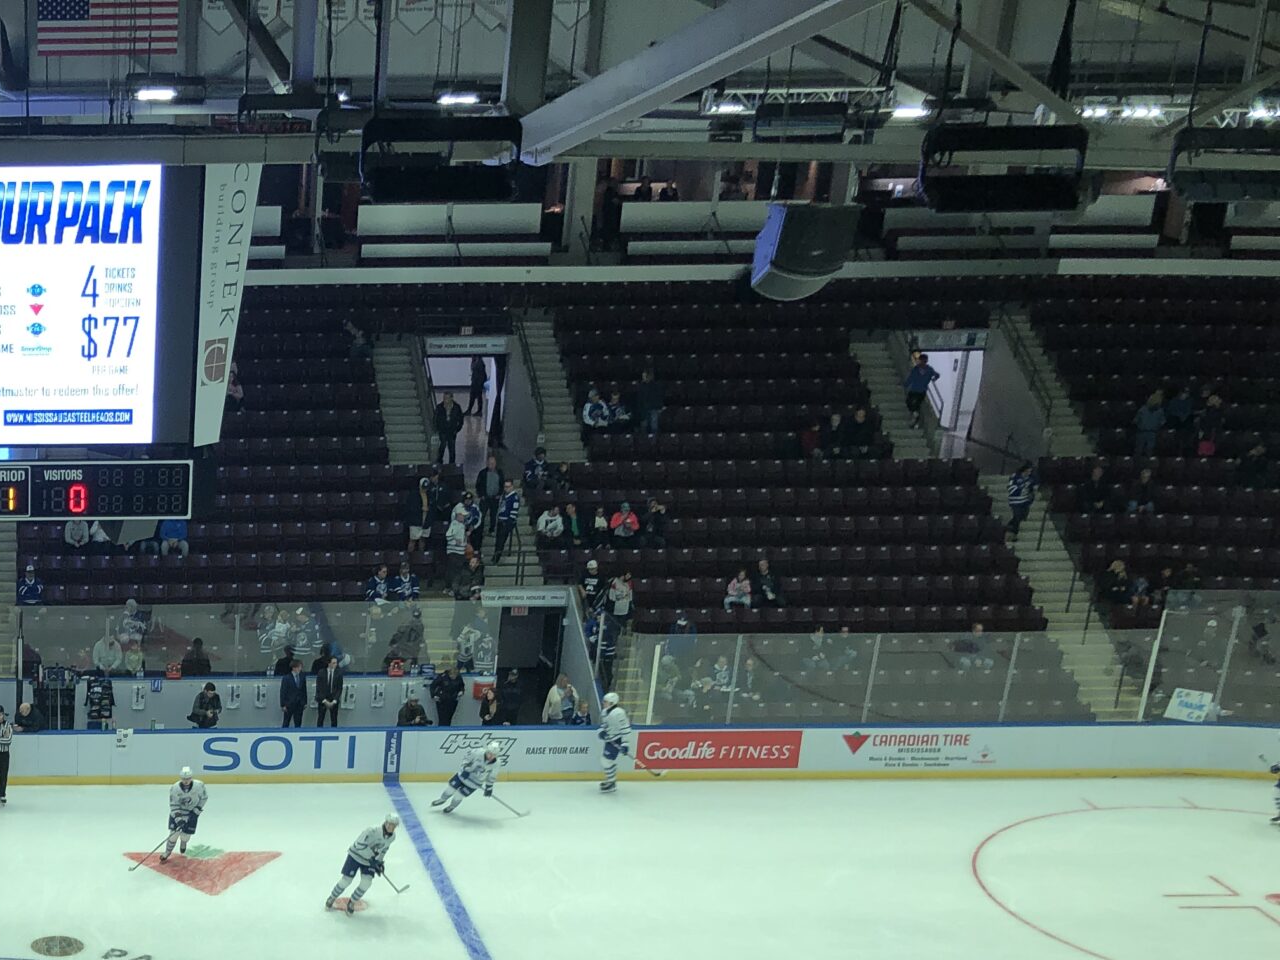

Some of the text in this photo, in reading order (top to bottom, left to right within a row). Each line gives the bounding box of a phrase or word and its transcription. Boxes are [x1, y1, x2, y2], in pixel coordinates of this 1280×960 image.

[53, 180, 152, 245] PACK
[220, 163, 250, 328] CONTEK
[104, 267, 136, 279] TICKETS
[80, 264, 100, 308] 4
[105, 282, 133, 294] DRINKS
[81, 313, 140, 362] $77
[41, 386, 51, 397] to
[53, 384, 90, 397] redeem
[92, 384, 109, 396] this
[112, 384, 139, 396] offer!
[43, 469, 83, 481] VISITORS
[8, 487, 15, 511] 1
[69, 485, 86, 513] 0
[525, 746, 590, 755] RAISE YOUR GAME
[643, 740, 792, 760] GoodLife FITNESS
[872, 734, 971, 747] CANADIAN TIRE
[202, 735, 357, 772] SOTI
